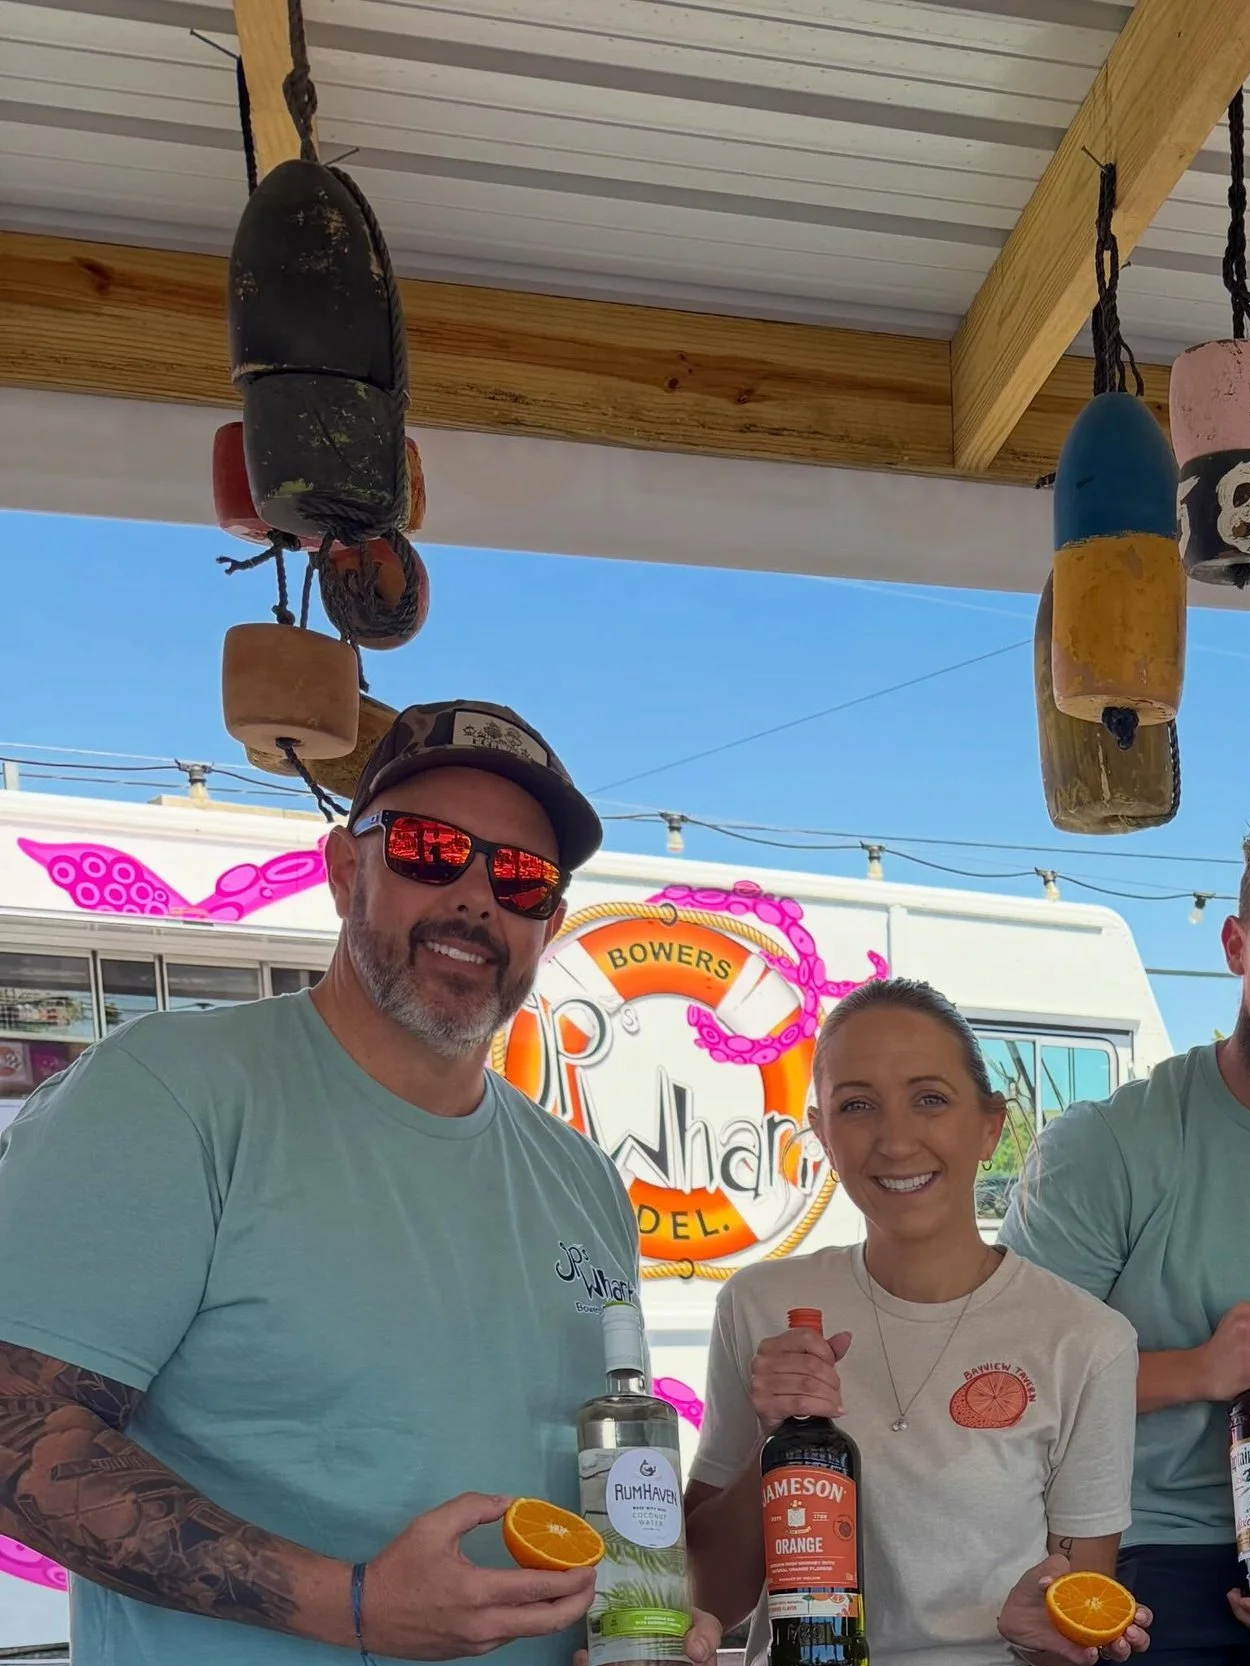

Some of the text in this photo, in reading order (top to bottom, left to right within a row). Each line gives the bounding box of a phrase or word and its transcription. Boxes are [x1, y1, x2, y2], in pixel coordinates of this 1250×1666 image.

[607, 941, 733, 981] BOWERS
[963, 1362, 1036, 1402] BAYVIEW TAVERN
[761, 1477, 844, 1508] JAMESON
[775, 1537, 824, 1555] ORANGE
